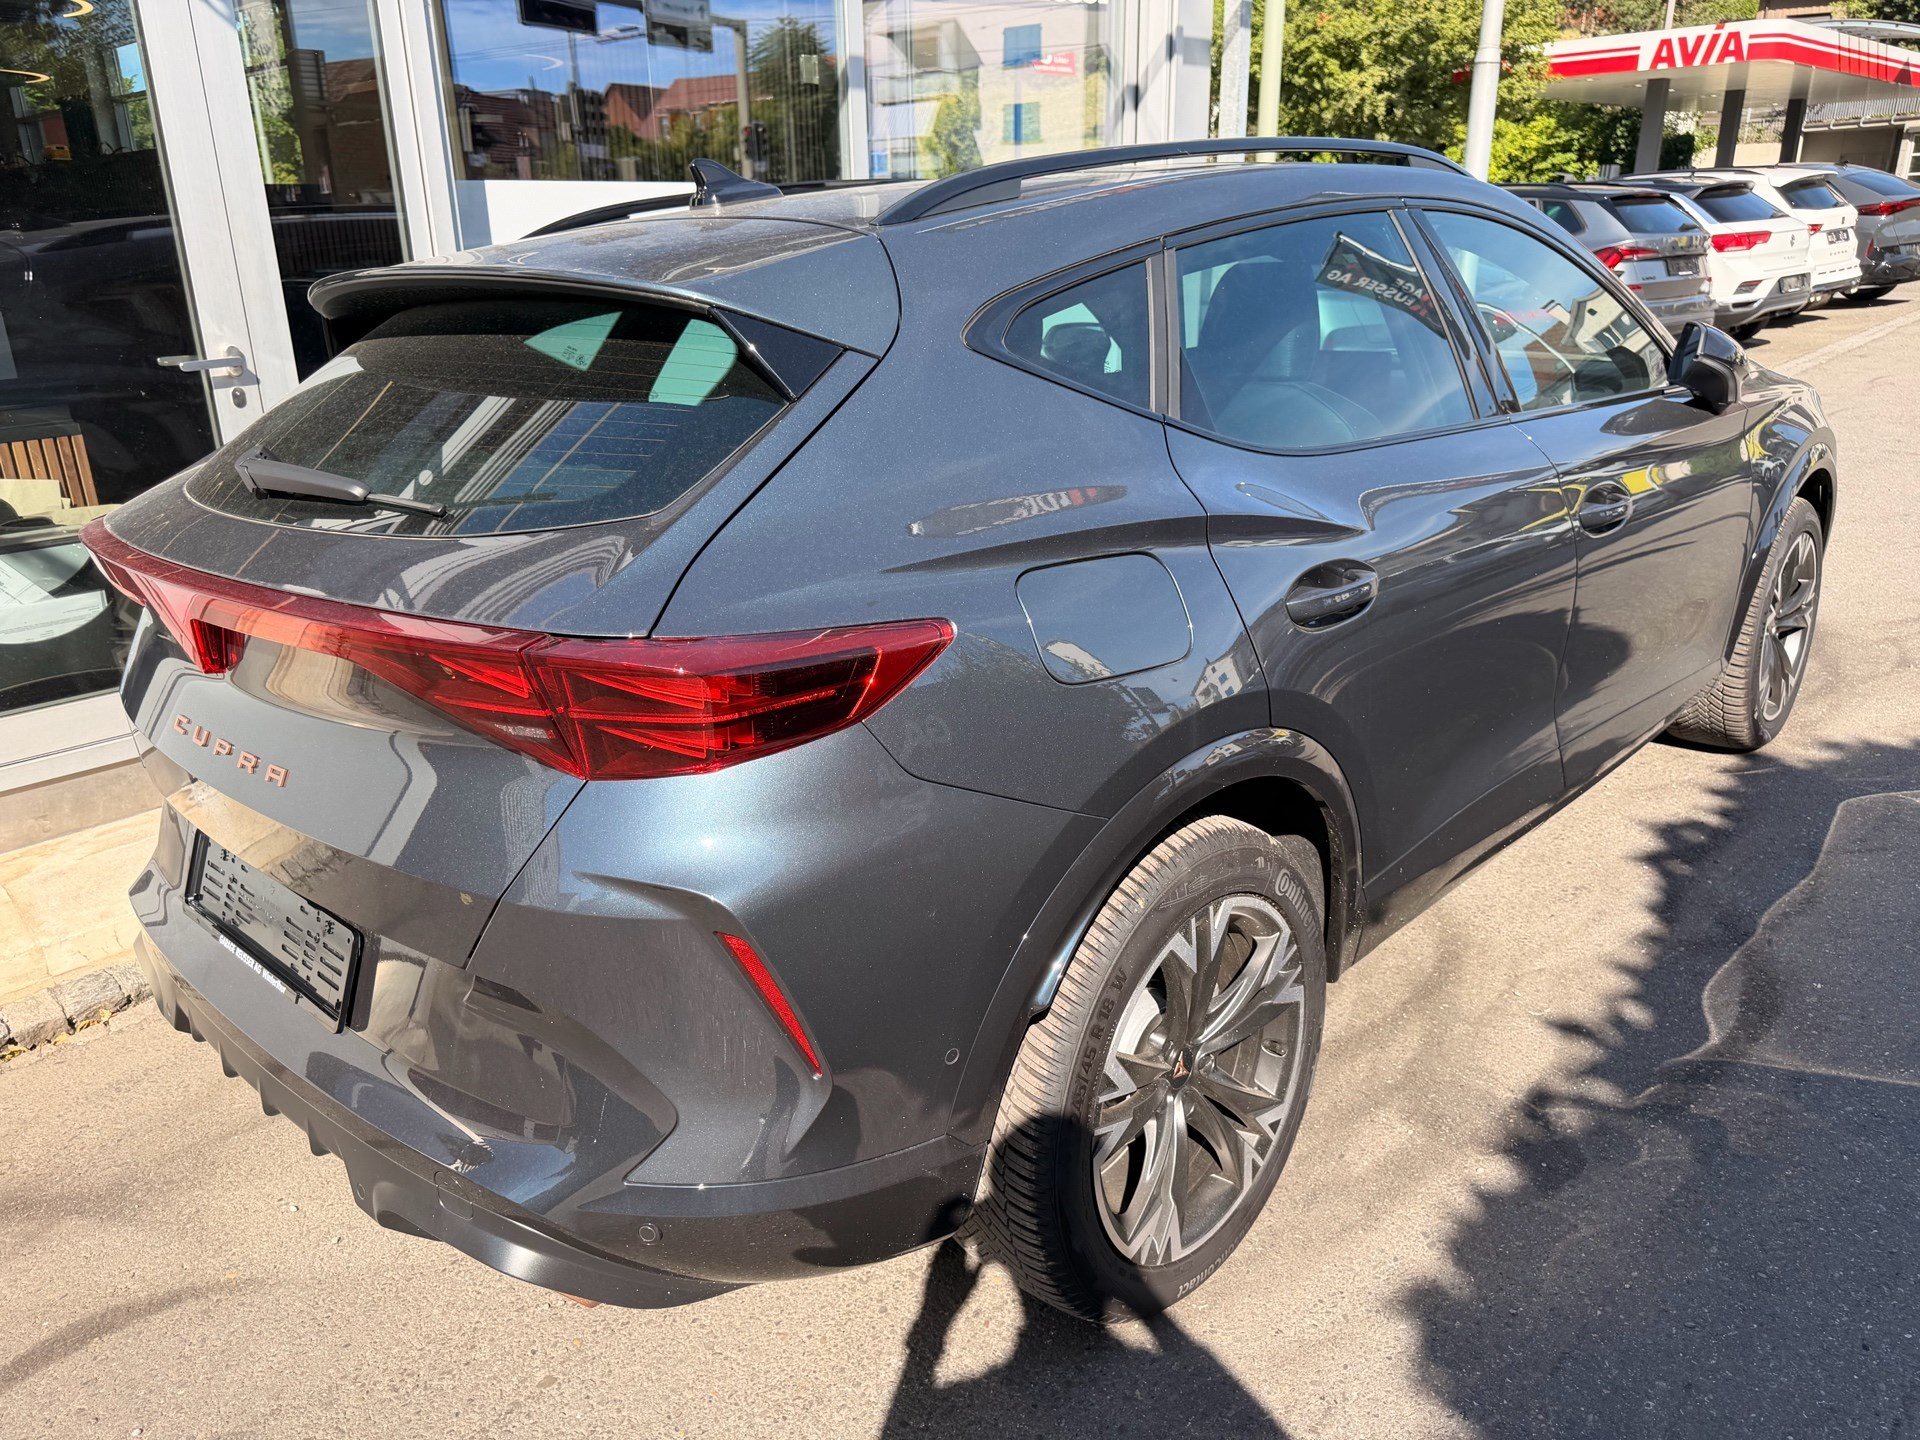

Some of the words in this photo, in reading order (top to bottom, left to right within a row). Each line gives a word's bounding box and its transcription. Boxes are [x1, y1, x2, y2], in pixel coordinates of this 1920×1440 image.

[1649, 24, 1745, 70] AVIA
[173, 713, 289, 788] CUPRA
[1097, 997, 1116, 1021] 18
[1090, 1023, 1105, 1040] R
